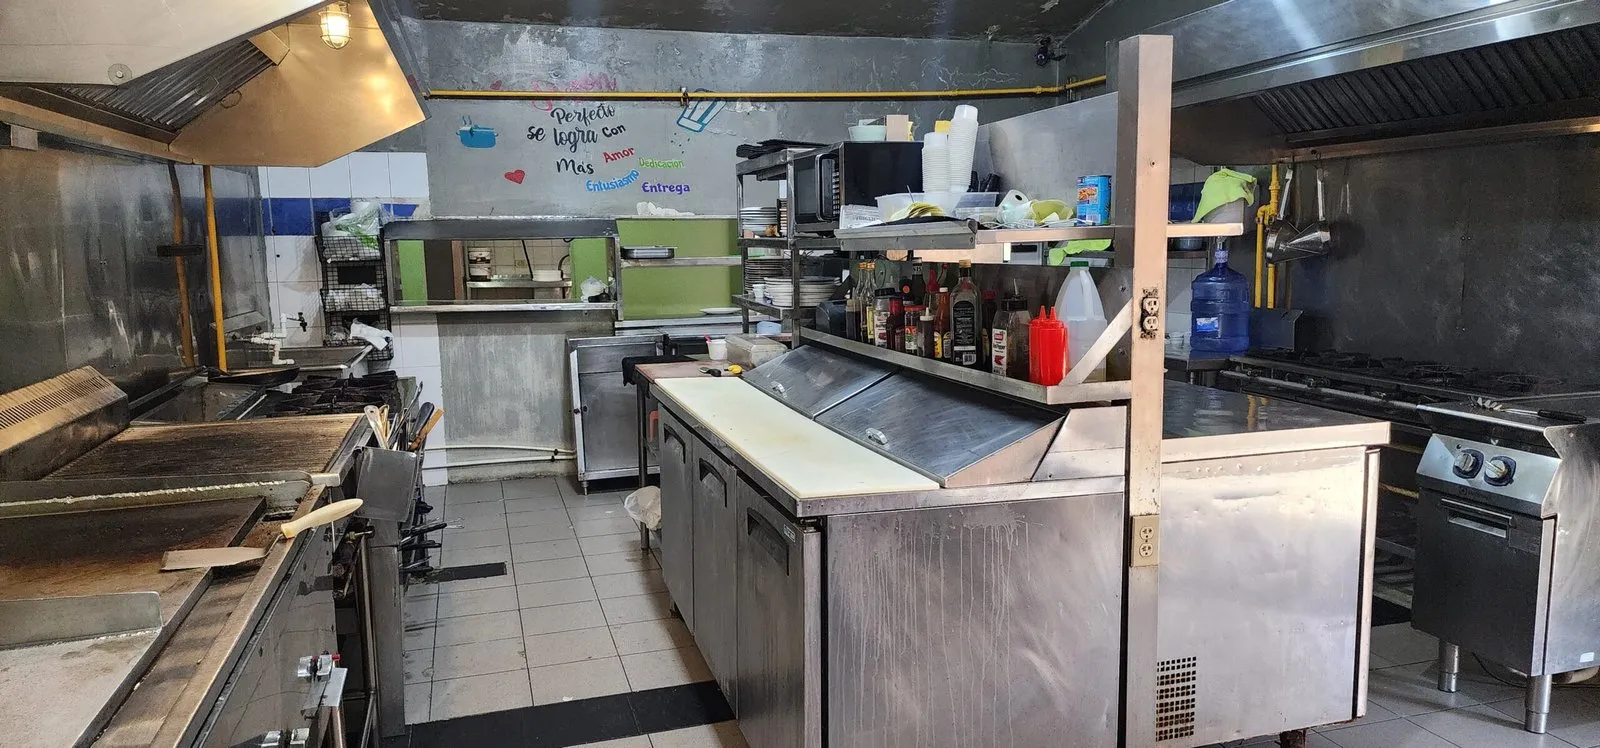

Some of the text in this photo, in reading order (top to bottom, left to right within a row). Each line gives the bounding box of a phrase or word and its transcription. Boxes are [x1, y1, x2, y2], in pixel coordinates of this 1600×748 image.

[550, 103, 615, 126] Perfecto
[553, 126, 599, 153] logra
[603, 147, 635, 164] Amor
[585, 168, 691, 195] Entusiasmo Entrega
